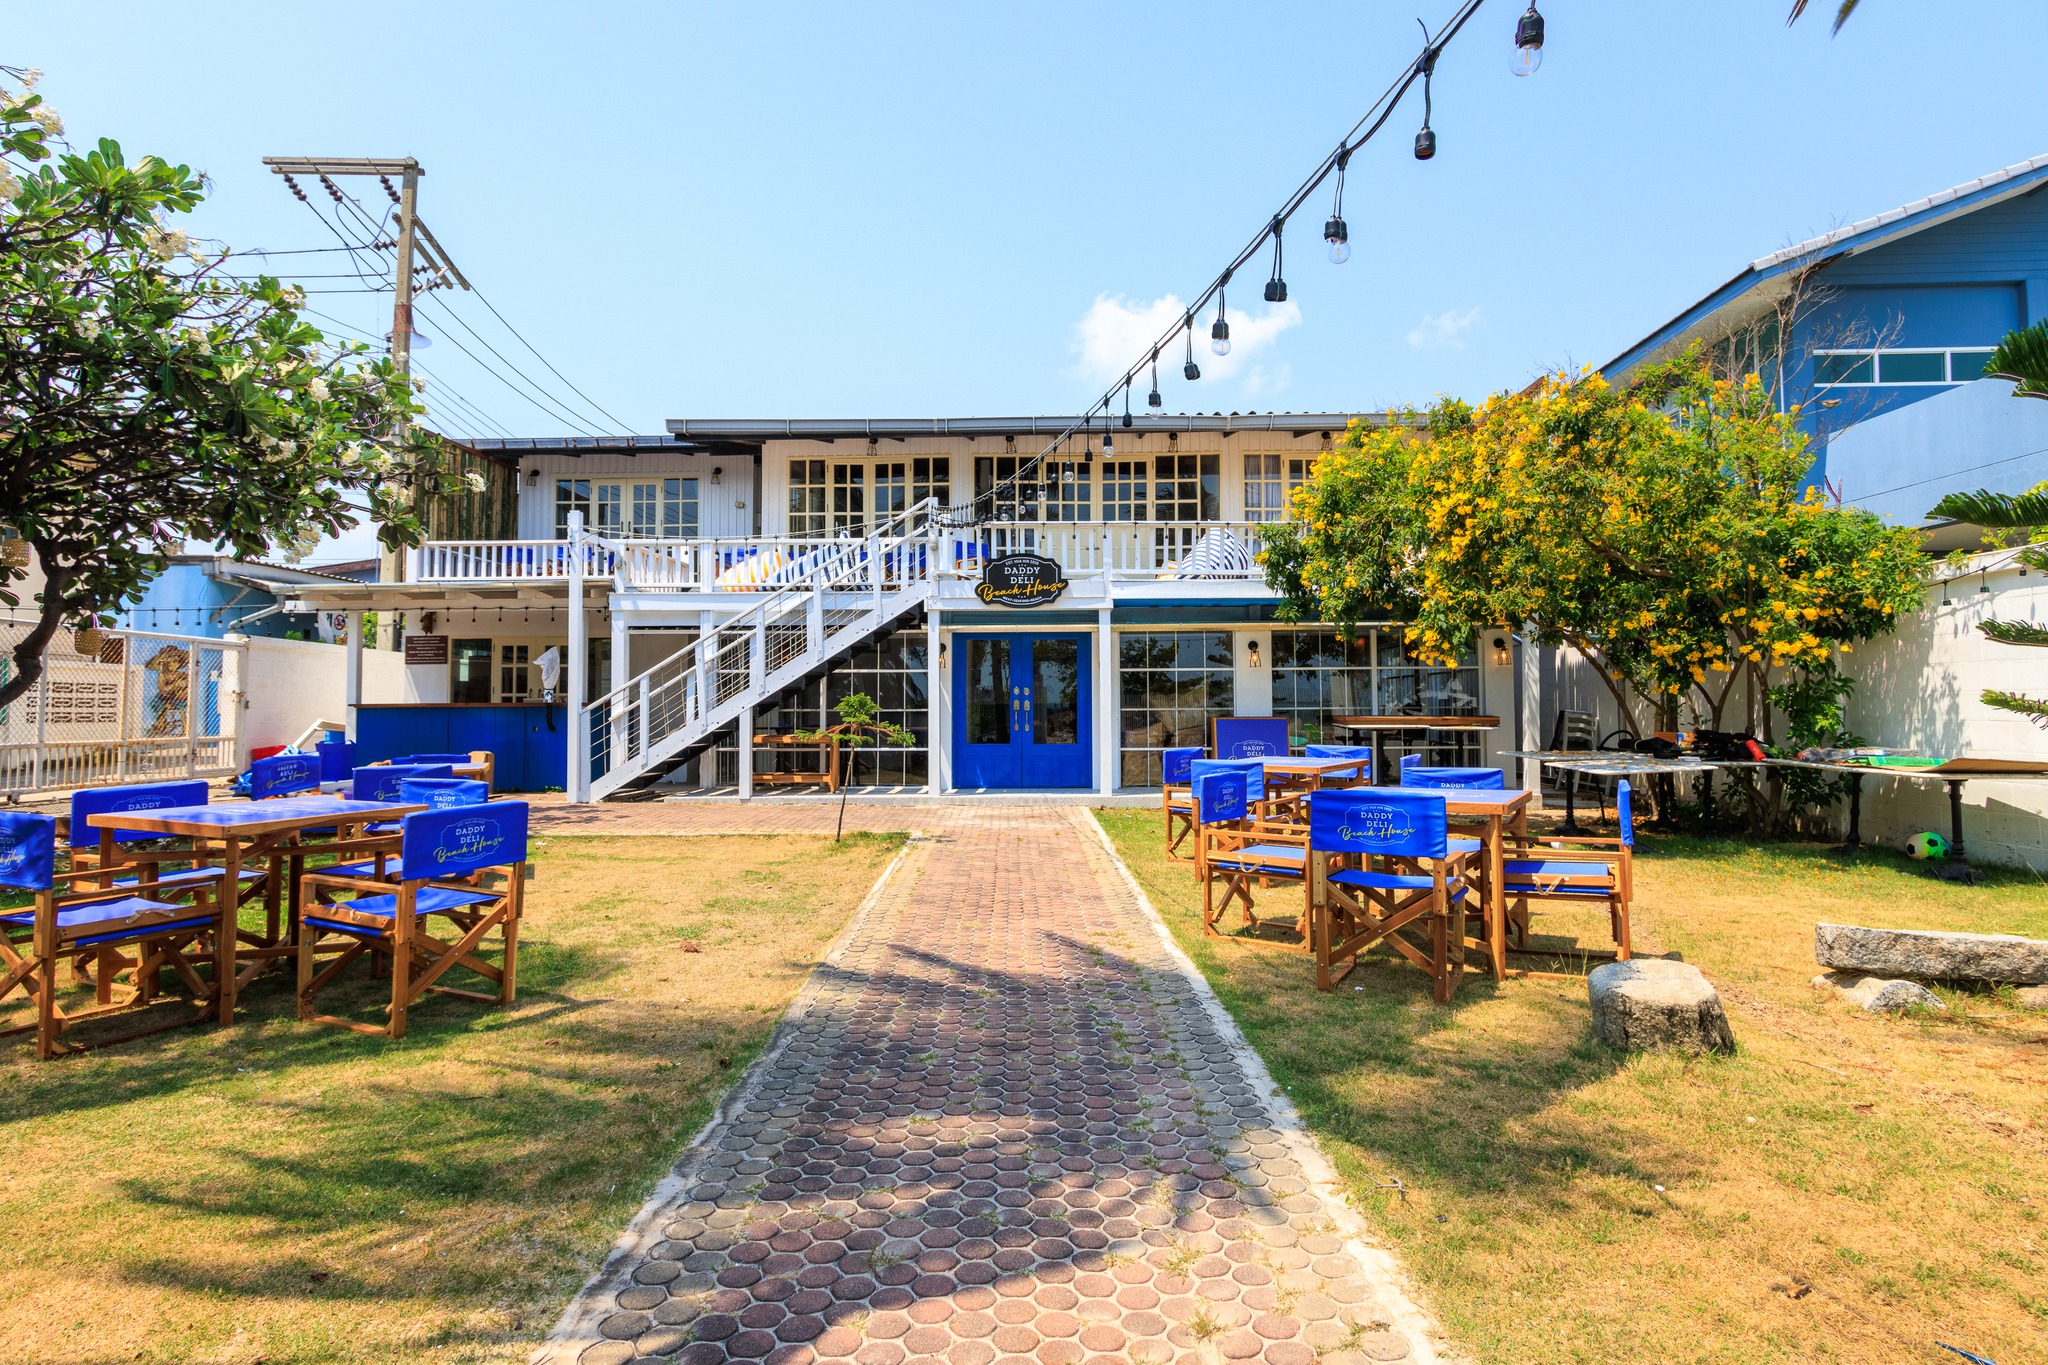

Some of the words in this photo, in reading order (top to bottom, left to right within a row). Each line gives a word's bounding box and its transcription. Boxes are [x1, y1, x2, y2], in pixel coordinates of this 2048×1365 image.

[1004, 567, 1040, 575] DADDY
[1010, 576, 1034, 584] DELI
[977, 583, 1022, 602] Beach
[1022, 579, 1066, 596] House
[128, 801, 161, 810] DADDY
[1360, 812, 1393, 820] DADDY
[1366, 820, 1387, 828] DELI
[455, 825, 486, 836] DADDY
[1337, 826, 1376, 841] Beach
[1376, 824, 1416, 839] House
[460, 835, 480, 844] DELI
[433, 844, 470, 863] Beach
[470, 836, 505, 853] House
